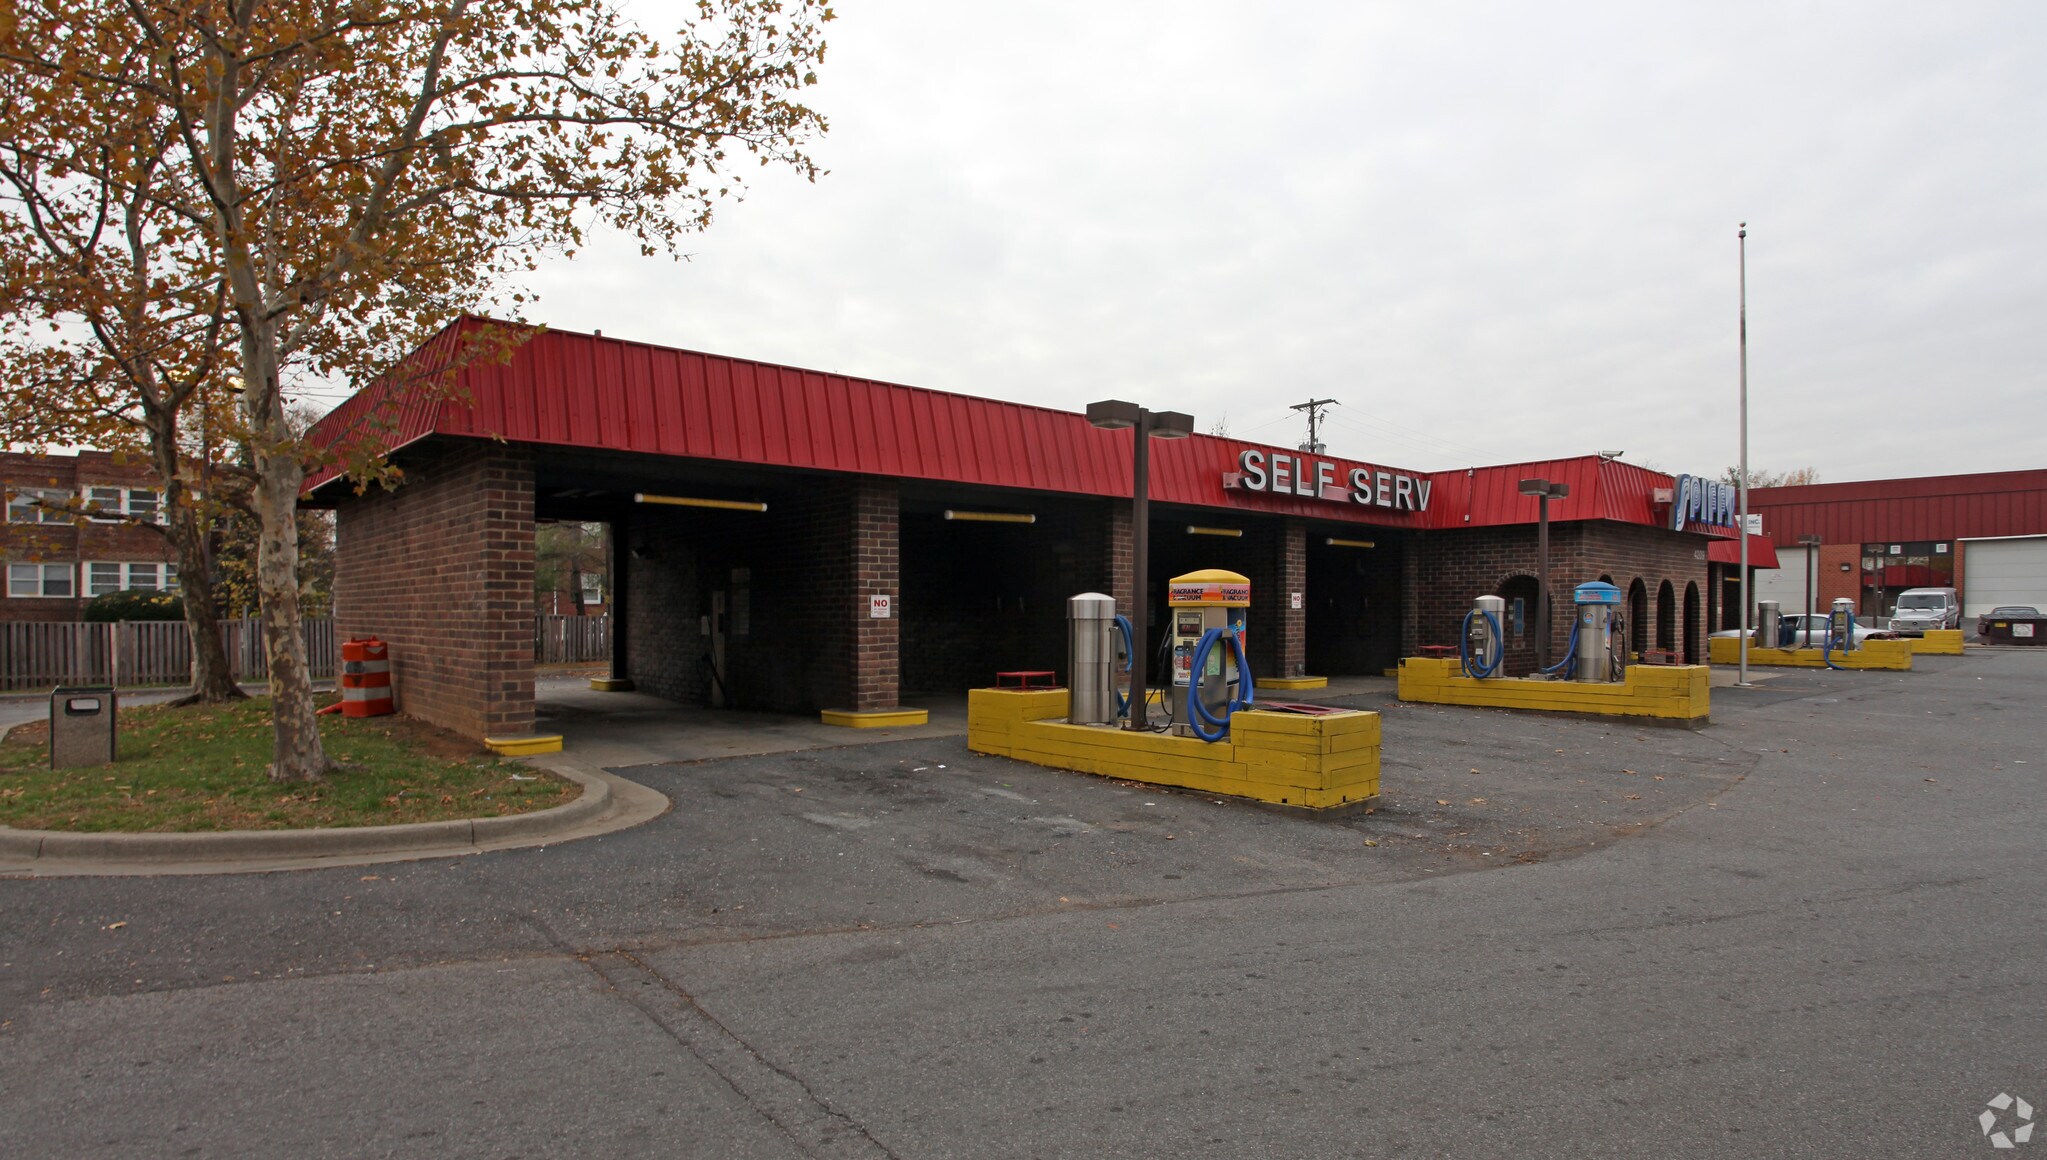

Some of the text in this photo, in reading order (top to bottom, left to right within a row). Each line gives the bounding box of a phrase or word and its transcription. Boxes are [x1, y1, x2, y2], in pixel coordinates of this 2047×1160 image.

[1240, 450, 1432, 511] SELF SERV
[1673, 474, 1735, 531] SPIFFY
